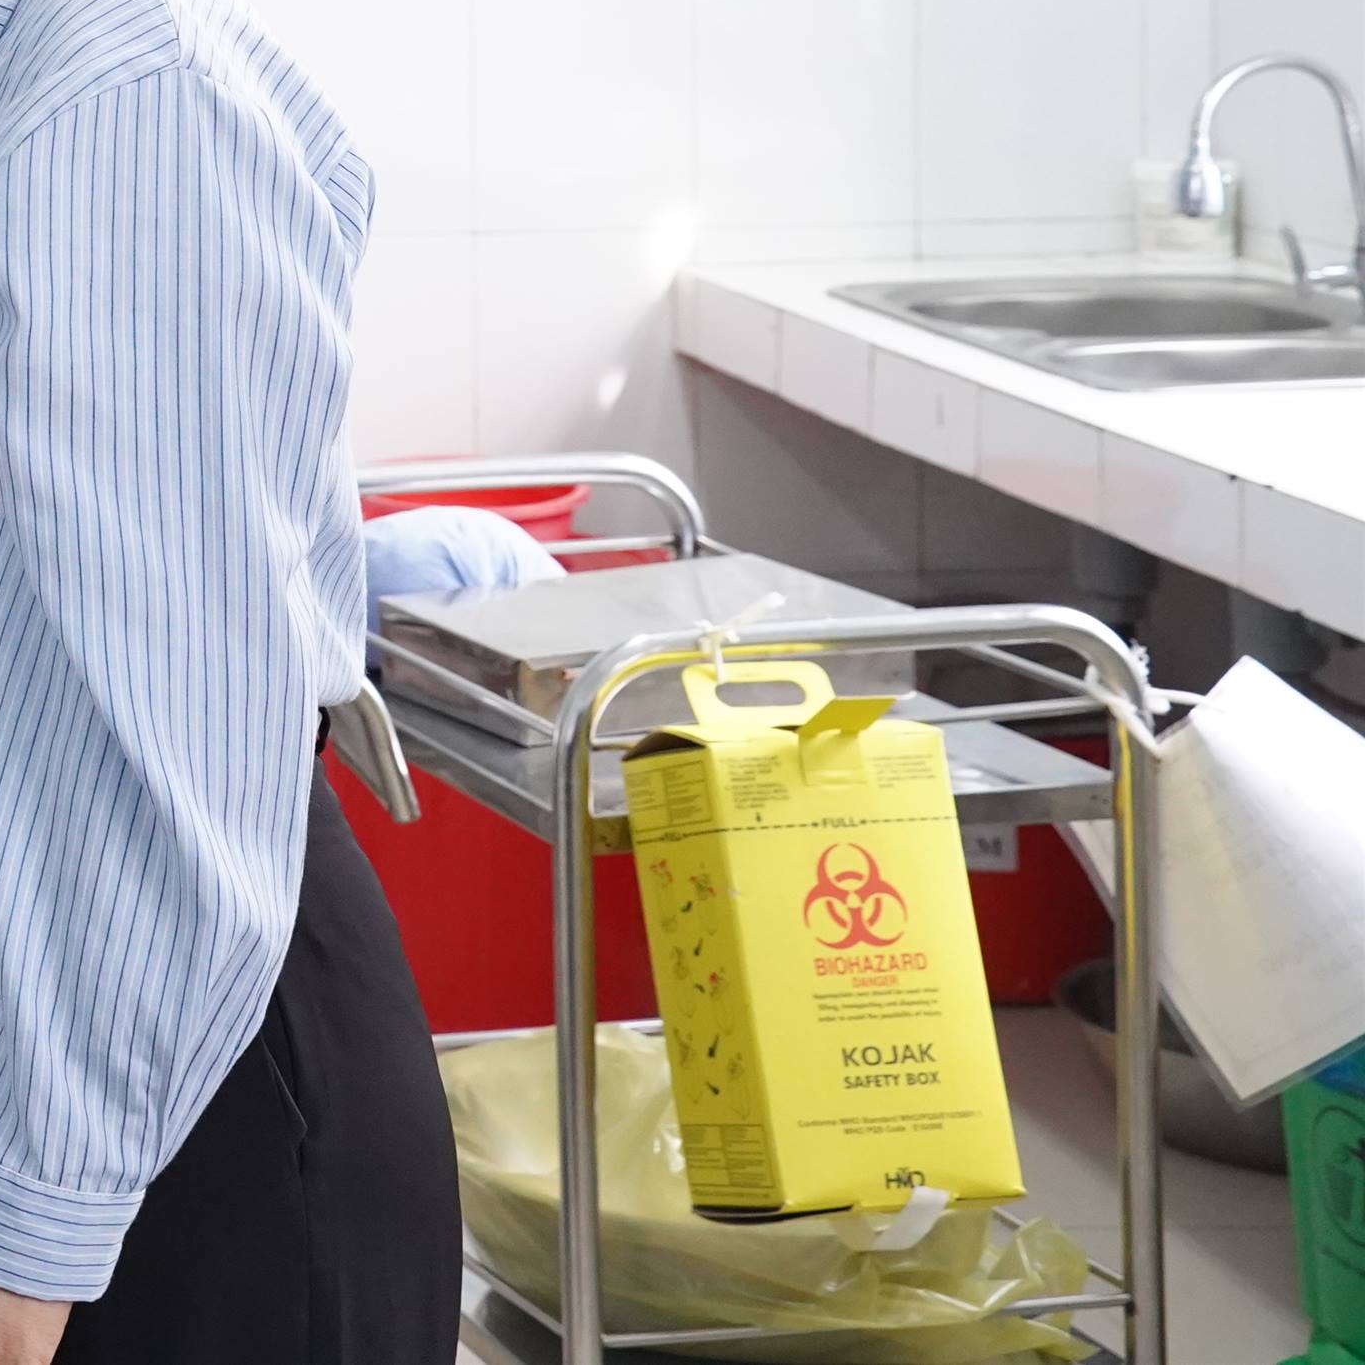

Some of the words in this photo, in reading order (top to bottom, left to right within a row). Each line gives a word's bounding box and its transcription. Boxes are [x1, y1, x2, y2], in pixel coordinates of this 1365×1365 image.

[822, 816, 859, 829] FULL
[813, 952, 929, 977] BIOHAZARD
[852, 976, 899, 988] DANGER
[841, 1043, 937, 1068] KOJAK
[843, 1073, 902, 1090] SAFETY
[905, 1070, 942, 1086] BOX
